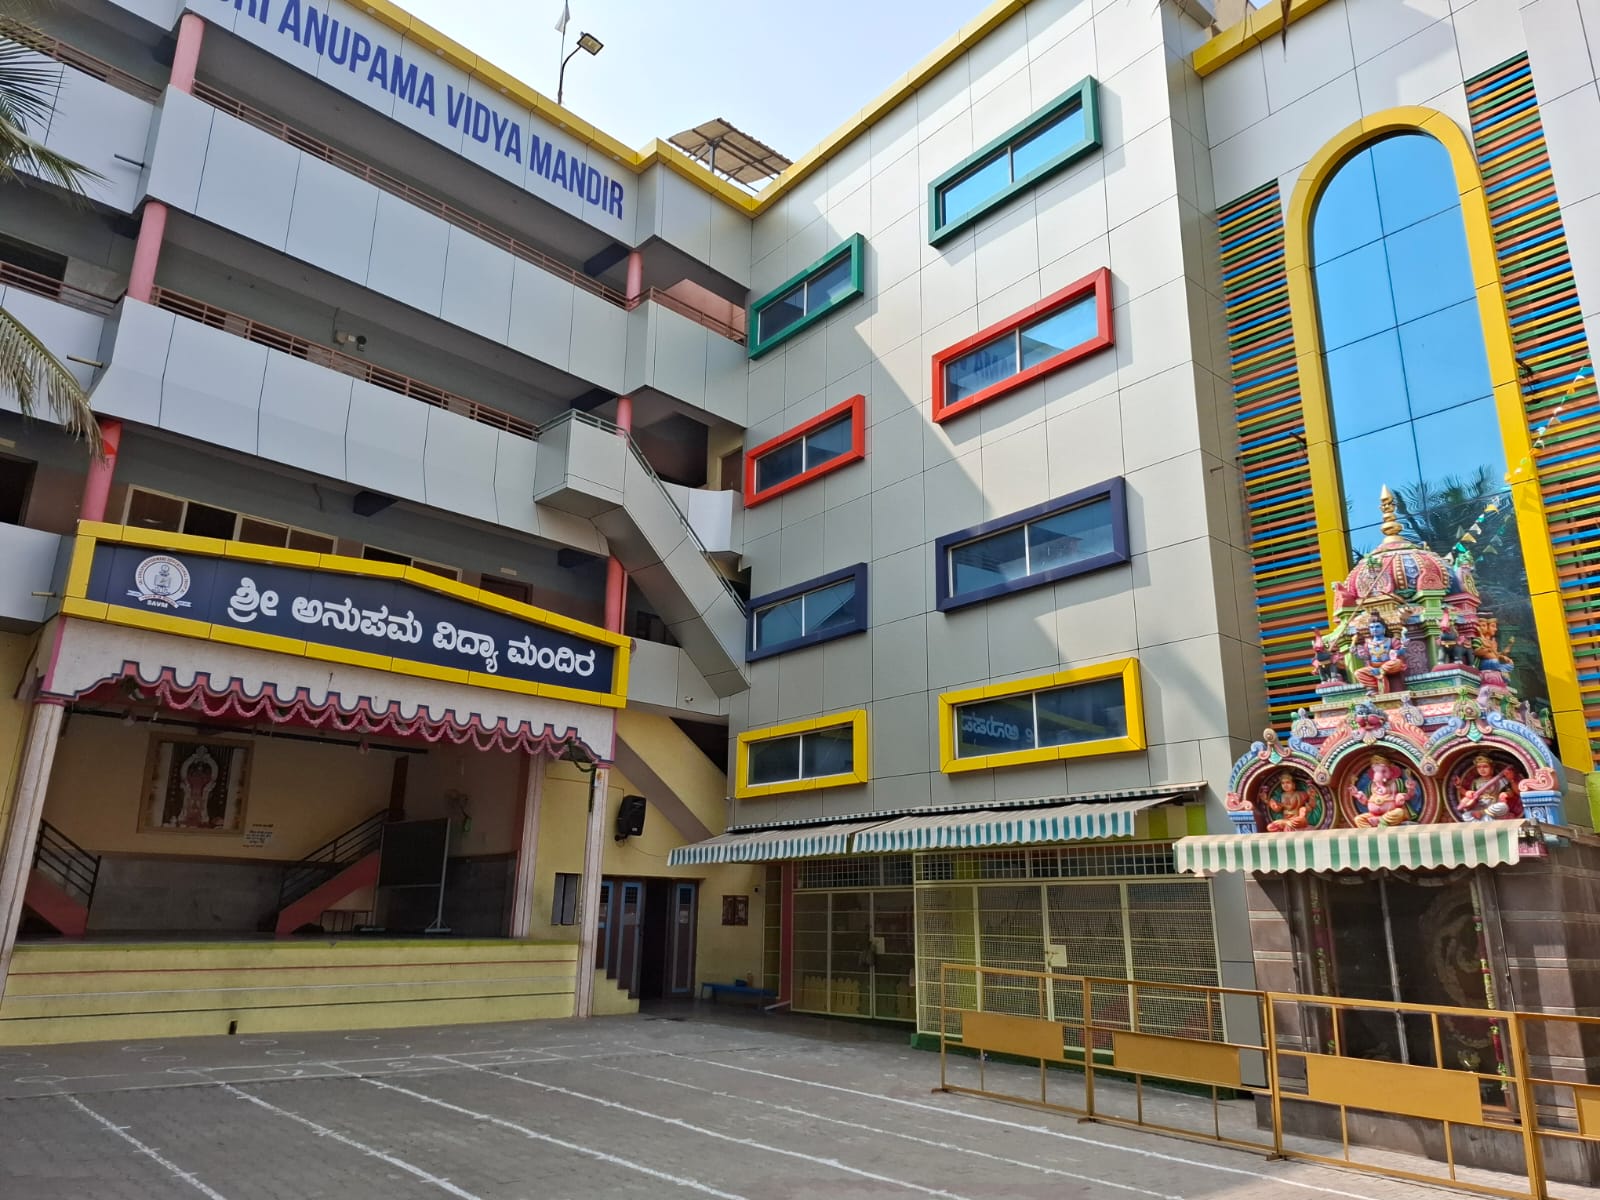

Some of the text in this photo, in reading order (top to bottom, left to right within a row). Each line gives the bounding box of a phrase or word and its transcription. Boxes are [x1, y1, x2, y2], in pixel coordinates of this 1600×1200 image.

[278, 0, 624, 220] ANUPAMA VIDYA MANDIR
[227, 576, 596, 677] ಶ್ರೀ ಅನುಪಮ ವಿದ್ಯಾ ಮಂದಿರ
